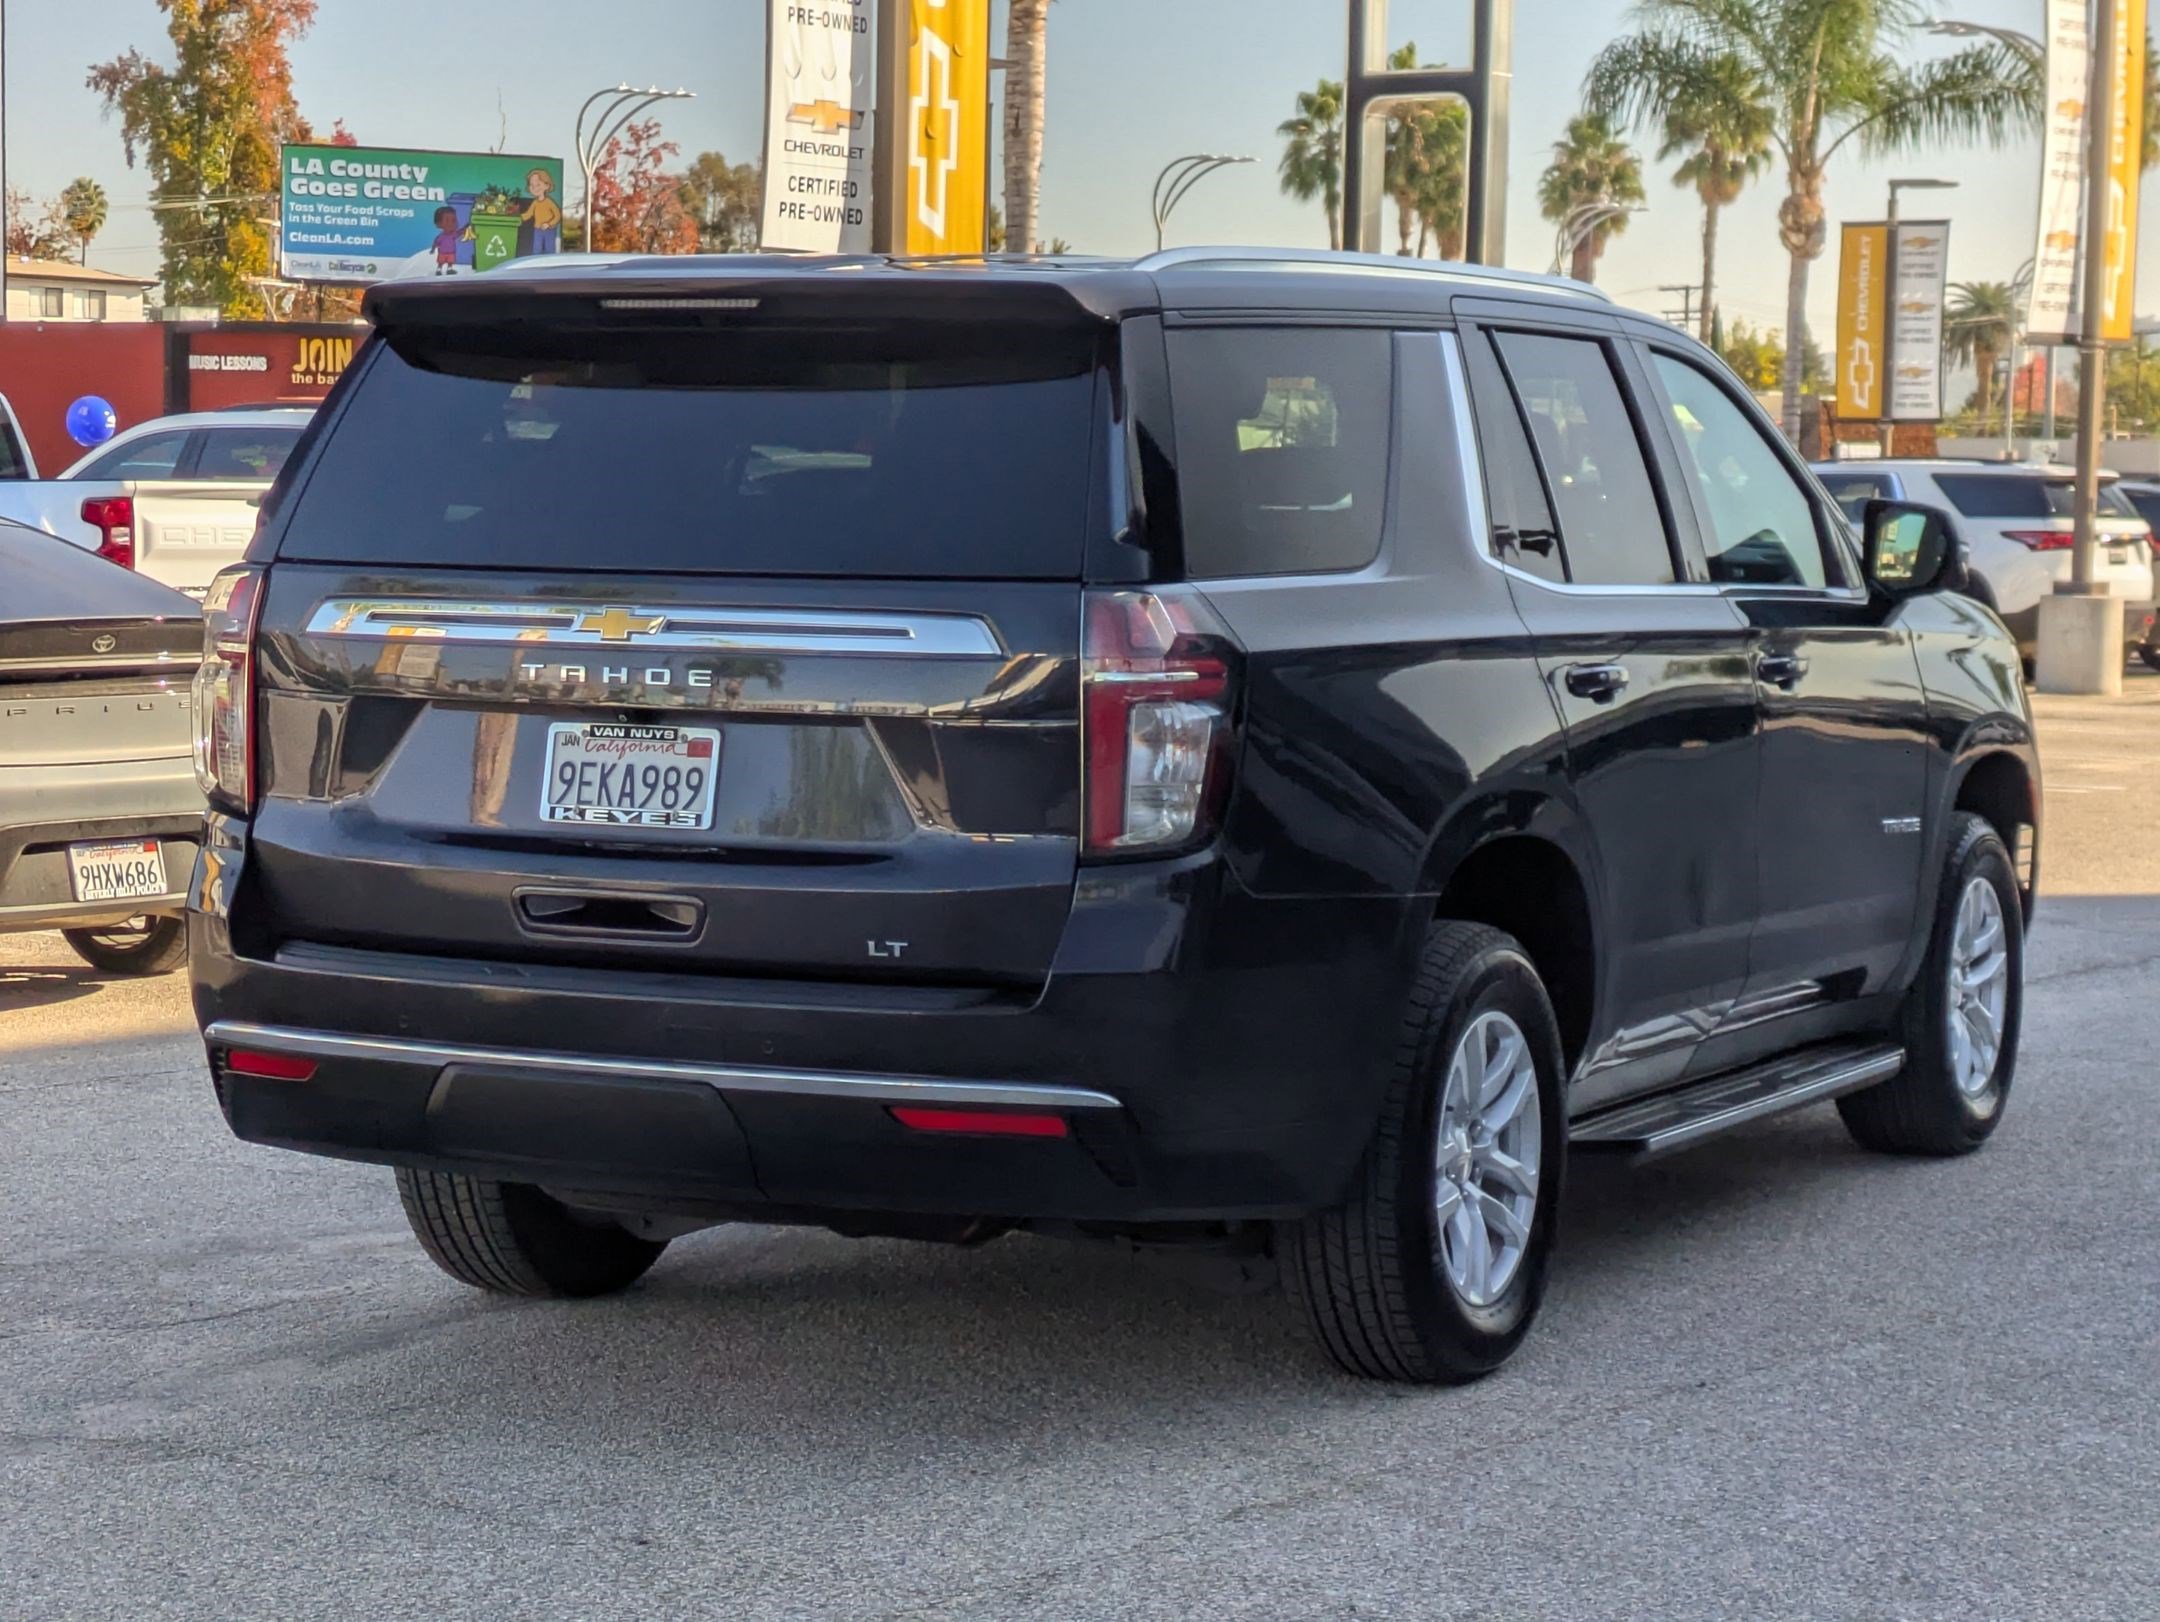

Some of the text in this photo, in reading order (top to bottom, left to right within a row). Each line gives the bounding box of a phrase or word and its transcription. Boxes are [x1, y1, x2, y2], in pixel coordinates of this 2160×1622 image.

[787, 6, 868, 34] PRE-OWNED
[784, 139, 865, 160] CHEVROLET
[290, 157, 429, 183] LA County
[290, 178, 445, 201] Goes Green
[787, 175, 858, 198] CERTIFIED
[289, 202, 414, 218] Toss Your Food Scraps
[302, 214, 321, 224] the
[324, 215, 357, 226] Green
[360, 216, 379, 227] Bin
[778, 201, 863, 225] PRE-OWNED
[289, 231, 374, 245] CleanLA.com
[189, 354, 268, 372] MUSIC LESSONS
[292, 338, 353, 372] JOIN
[291, 373, 313, 384] the
[521, 663, 712, 687] TAHOE
[561, 734, 580, 747] JAN
[593, 726, 675, 740] VAN NUYS
[585, 738, 687, 760] California
[555, 760, 704, 811] 9EKA989
[554, 807, 696, 827] KEYES
[80, 860, 158, 889] 9HXW686
[867, 940, 909, 957] LT
